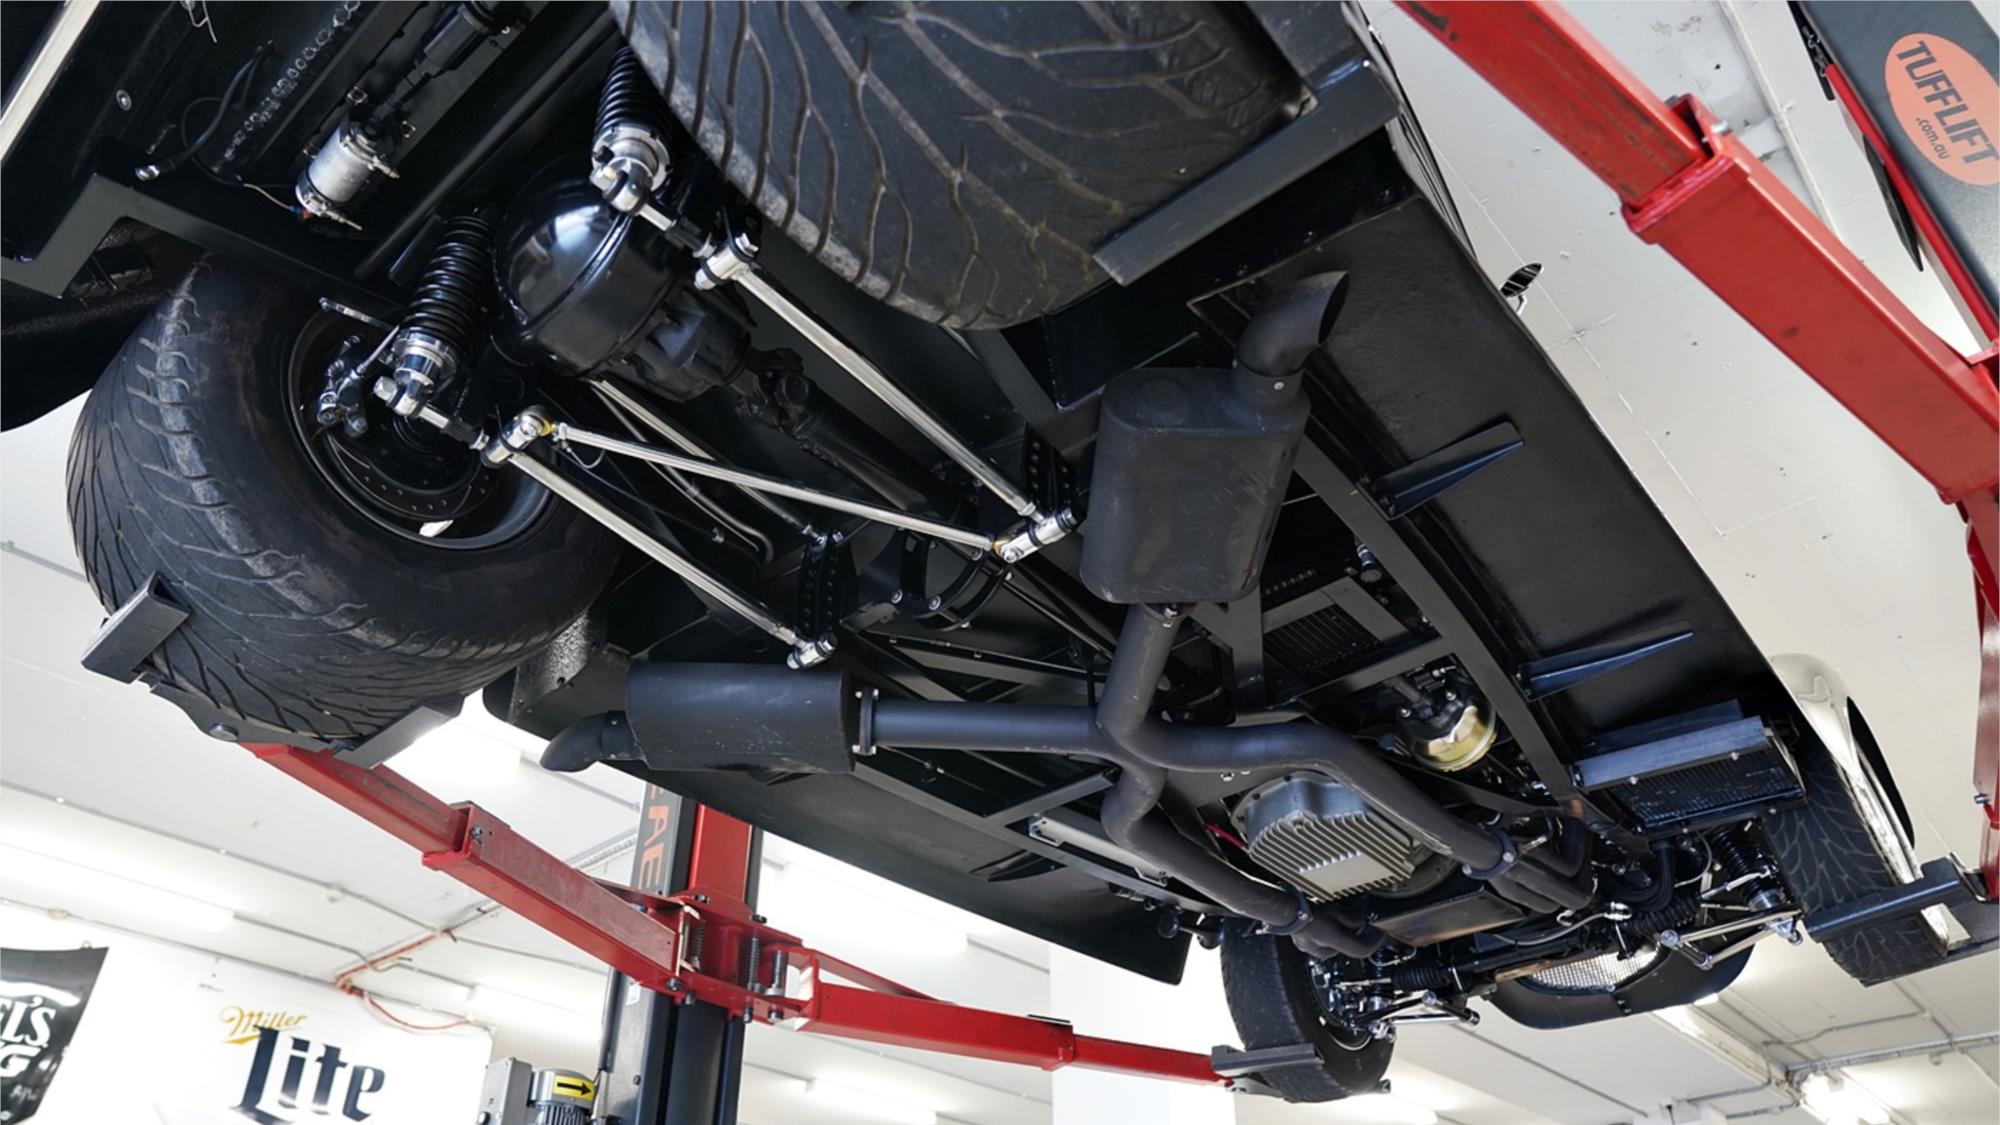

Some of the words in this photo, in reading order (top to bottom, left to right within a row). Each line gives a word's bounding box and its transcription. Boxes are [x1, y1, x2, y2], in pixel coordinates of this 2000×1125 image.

[1896, 41, 1999, 164] TUFFLIFT
[1916, 117, 1950, 160] .com.au
[220, 1005, 308, 1037] Miller
[228, 1024, 386, 1125] Lite
